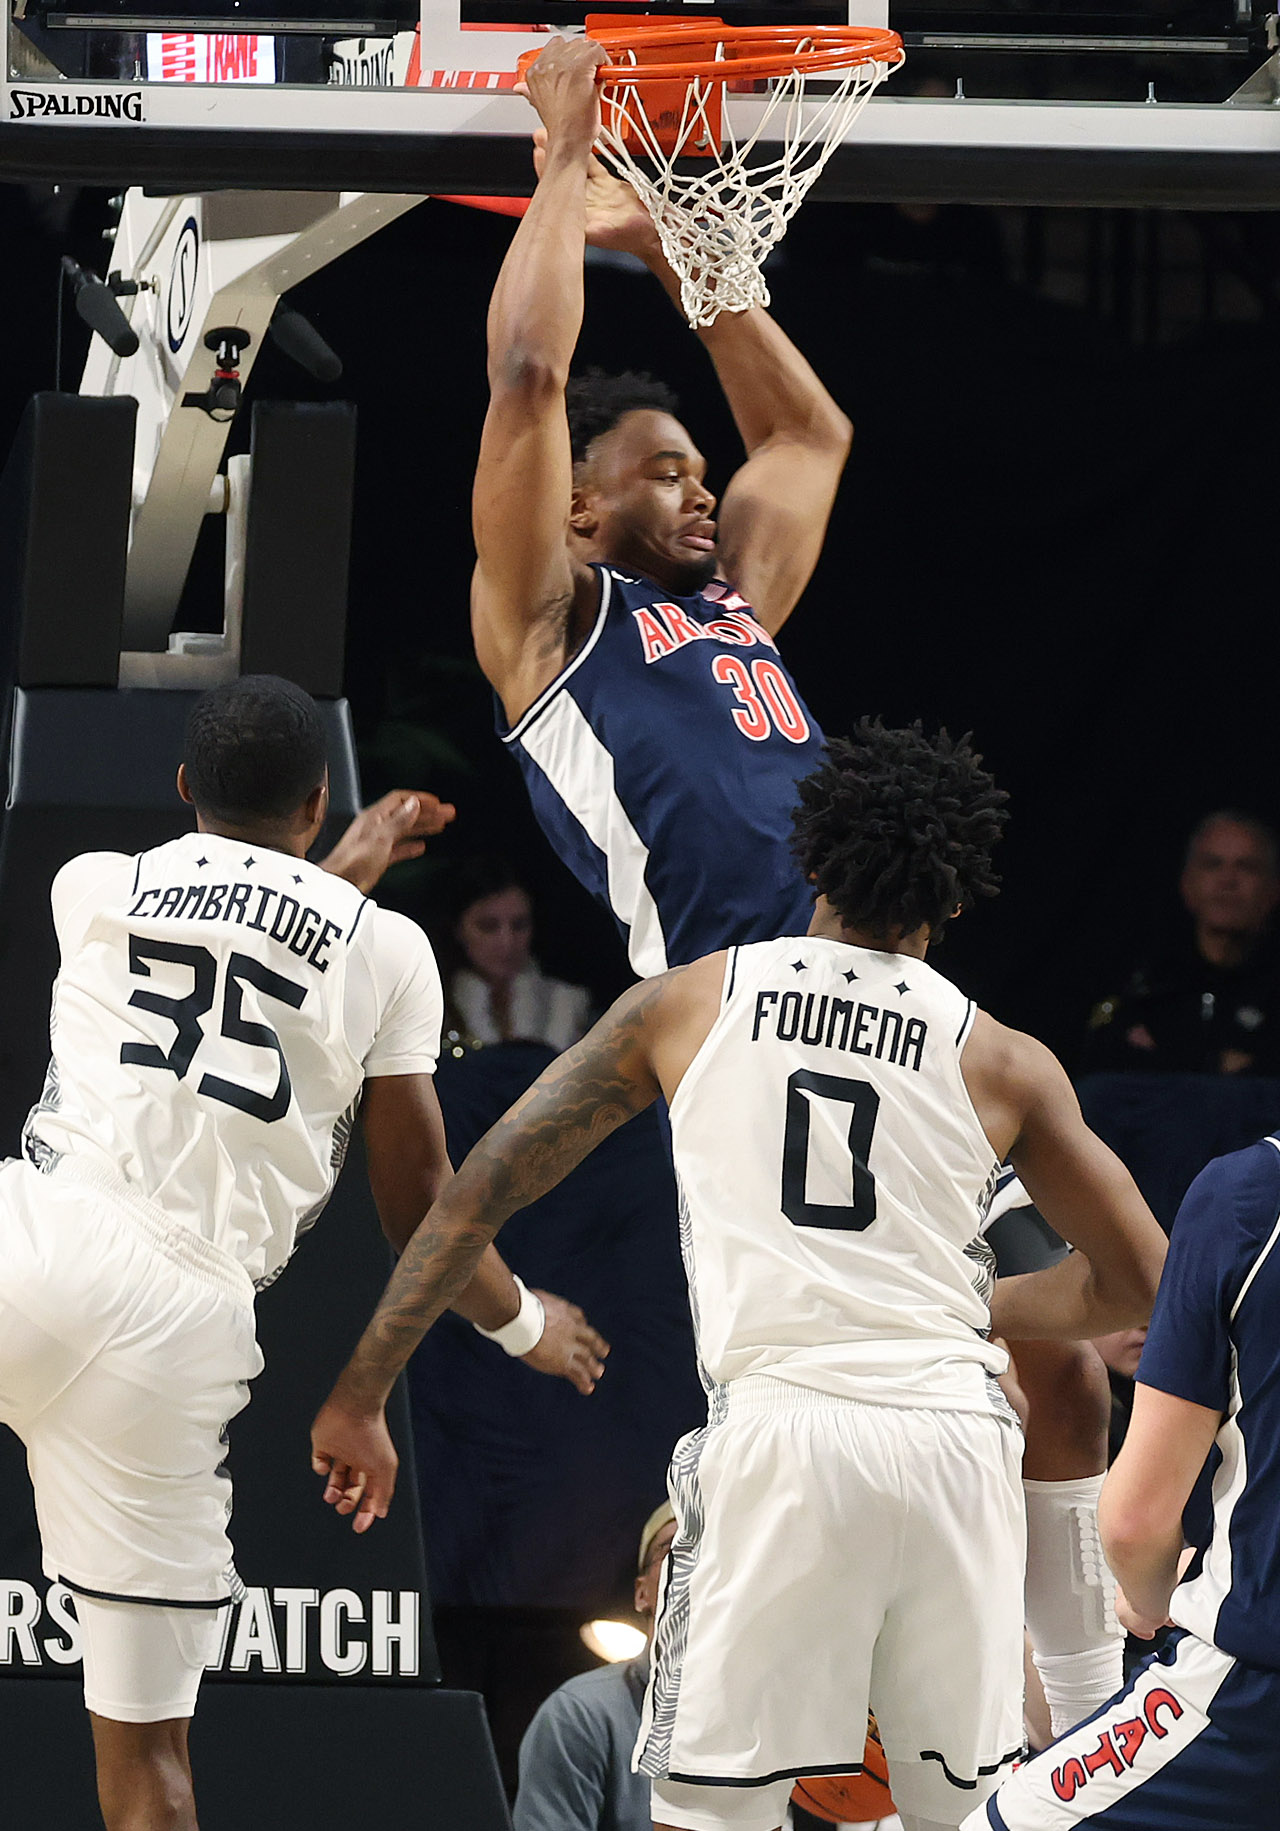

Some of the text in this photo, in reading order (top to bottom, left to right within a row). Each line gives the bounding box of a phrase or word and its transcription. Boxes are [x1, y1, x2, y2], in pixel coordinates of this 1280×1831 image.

[10, 90, 146, 122] SPALDING
[329, 40, 394, 86] PALDING
[711, 654, 809, 744] 30
[128, 883, 343, 974] CAMBRIDGE
[120, 933, 309, 1123] 35
[752, 991, 928, 1072] FOUMENA
[781, 1068, 880, 1231] 0
[1051, 1688, 1184, 1802] CATS
